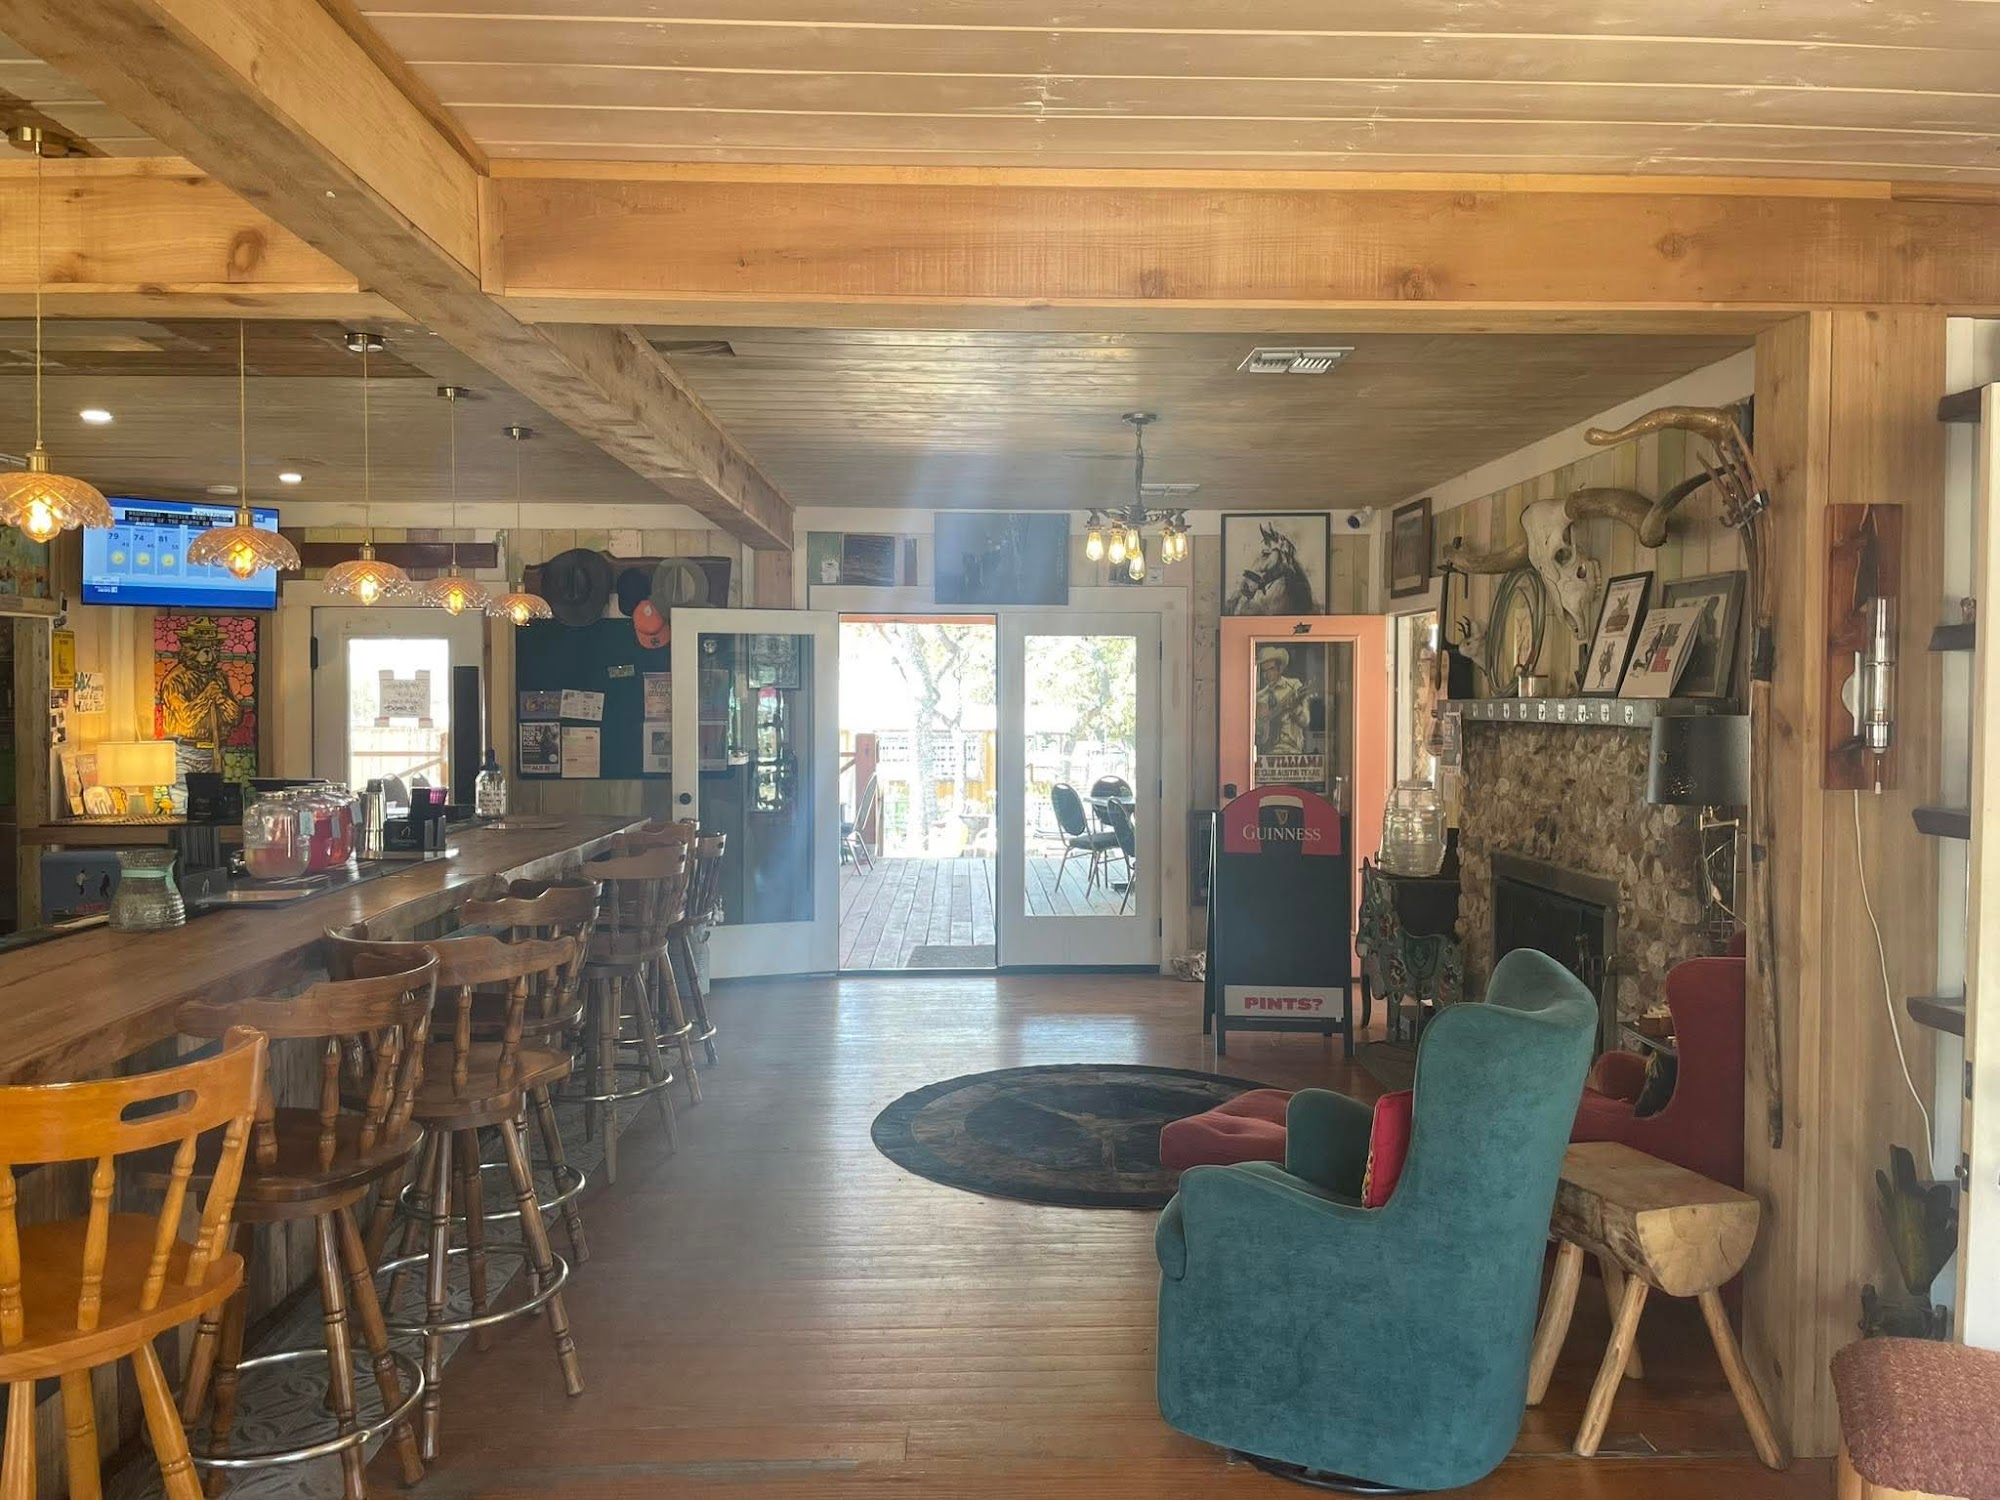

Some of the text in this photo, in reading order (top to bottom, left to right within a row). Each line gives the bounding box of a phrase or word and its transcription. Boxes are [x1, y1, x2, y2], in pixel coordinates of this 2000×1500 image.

[1278, 769, 1299, 777] AUSTIN
[1242, 823, 1321, 841] GUINNESS
[1244, 997, 1323, 1011] PINTS?
